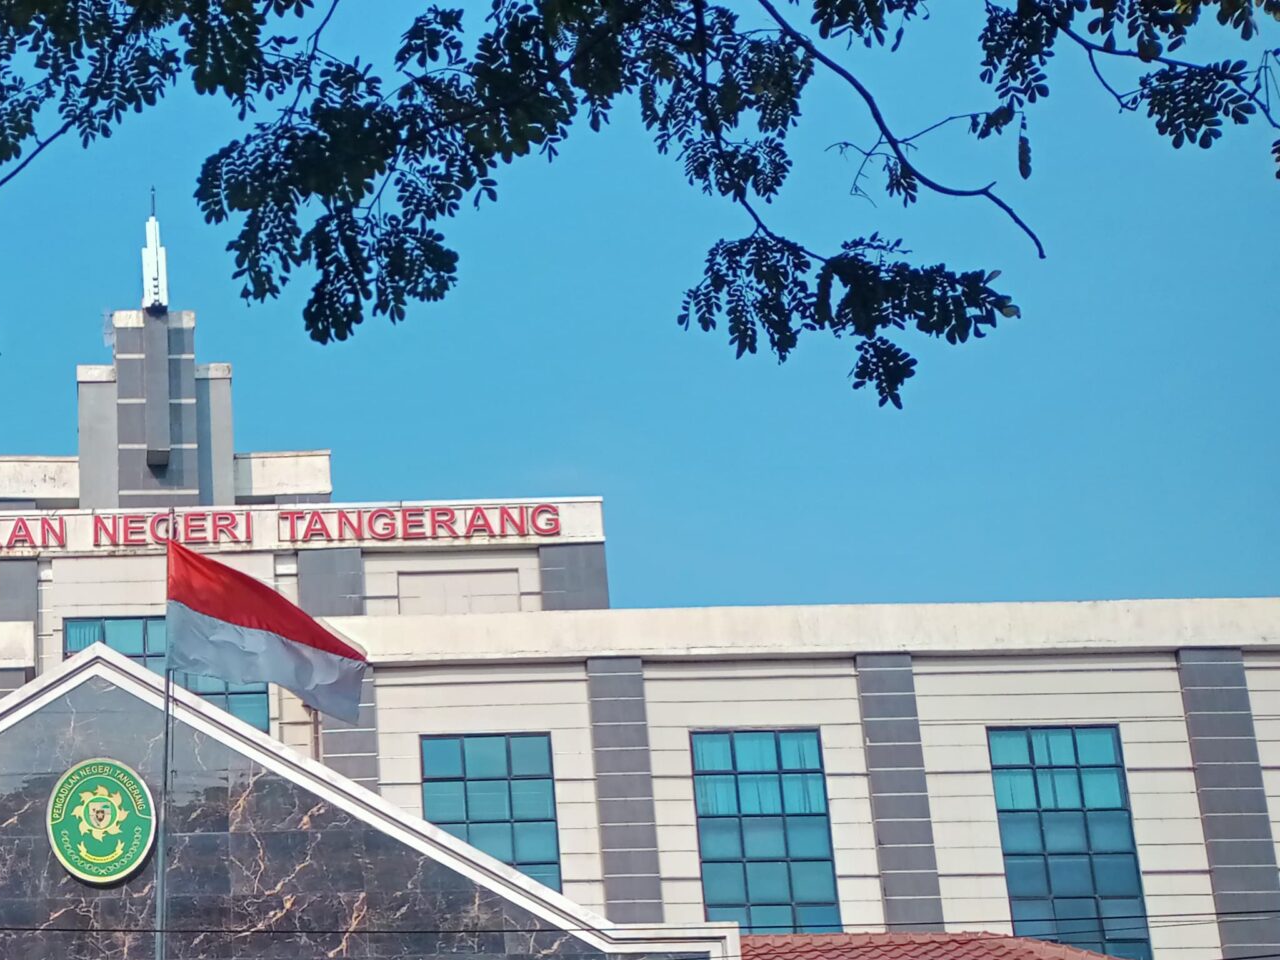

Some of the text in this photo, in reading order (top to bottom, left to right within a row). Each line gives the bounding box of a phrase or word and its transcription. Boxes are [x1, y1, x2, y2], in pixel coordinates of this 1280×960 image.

[93, 511, 252, 547] NEGERI
[278, 502, 563, 541] TANGERANG
[53, 765, 146, 819] PENGADILAN NEGERI TANGERANG
